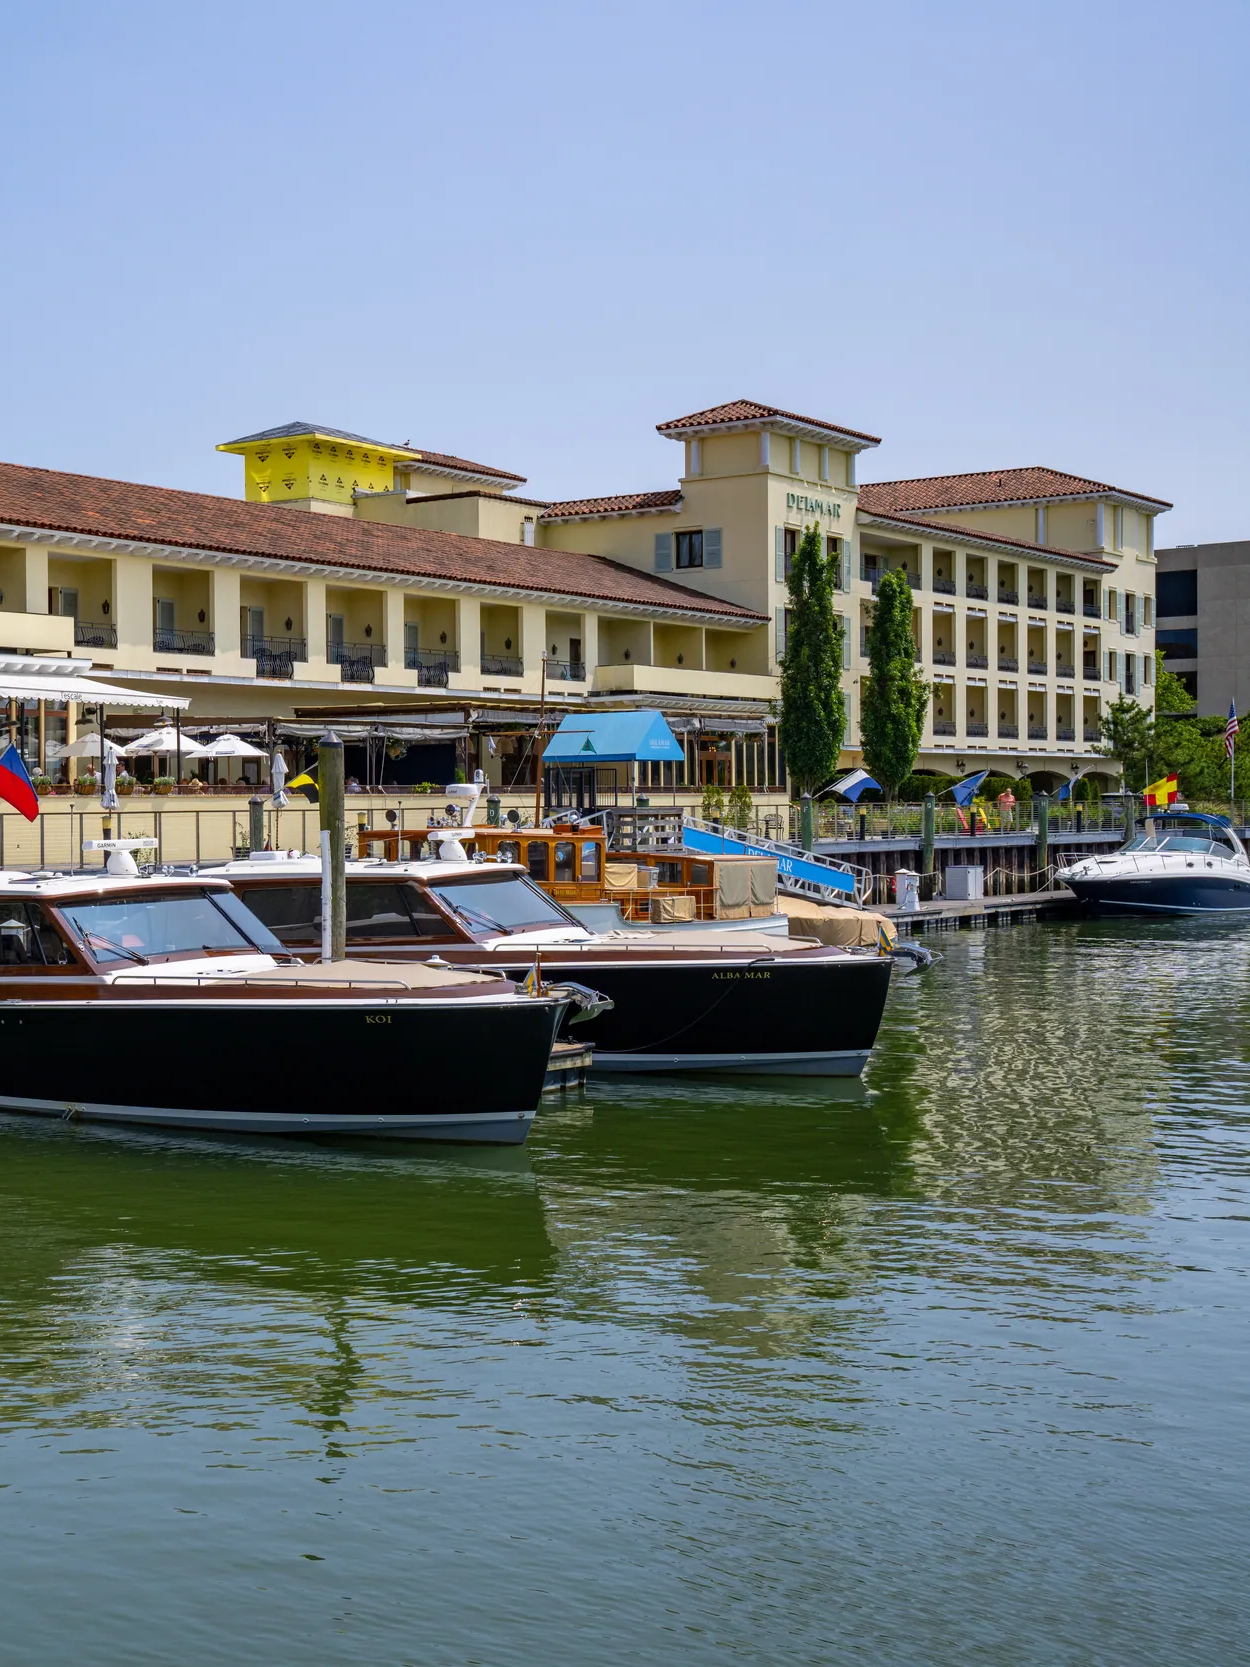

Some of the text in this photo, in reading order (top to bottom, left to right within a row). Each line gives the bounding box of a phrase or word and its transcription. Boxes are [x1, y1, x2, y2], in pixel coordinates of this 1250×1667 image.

[786, 492, 841, 518] DELAMAR
[711, 971, 771, 980] ALBA MAR
[364, 1015, 392, 1024] KOI
